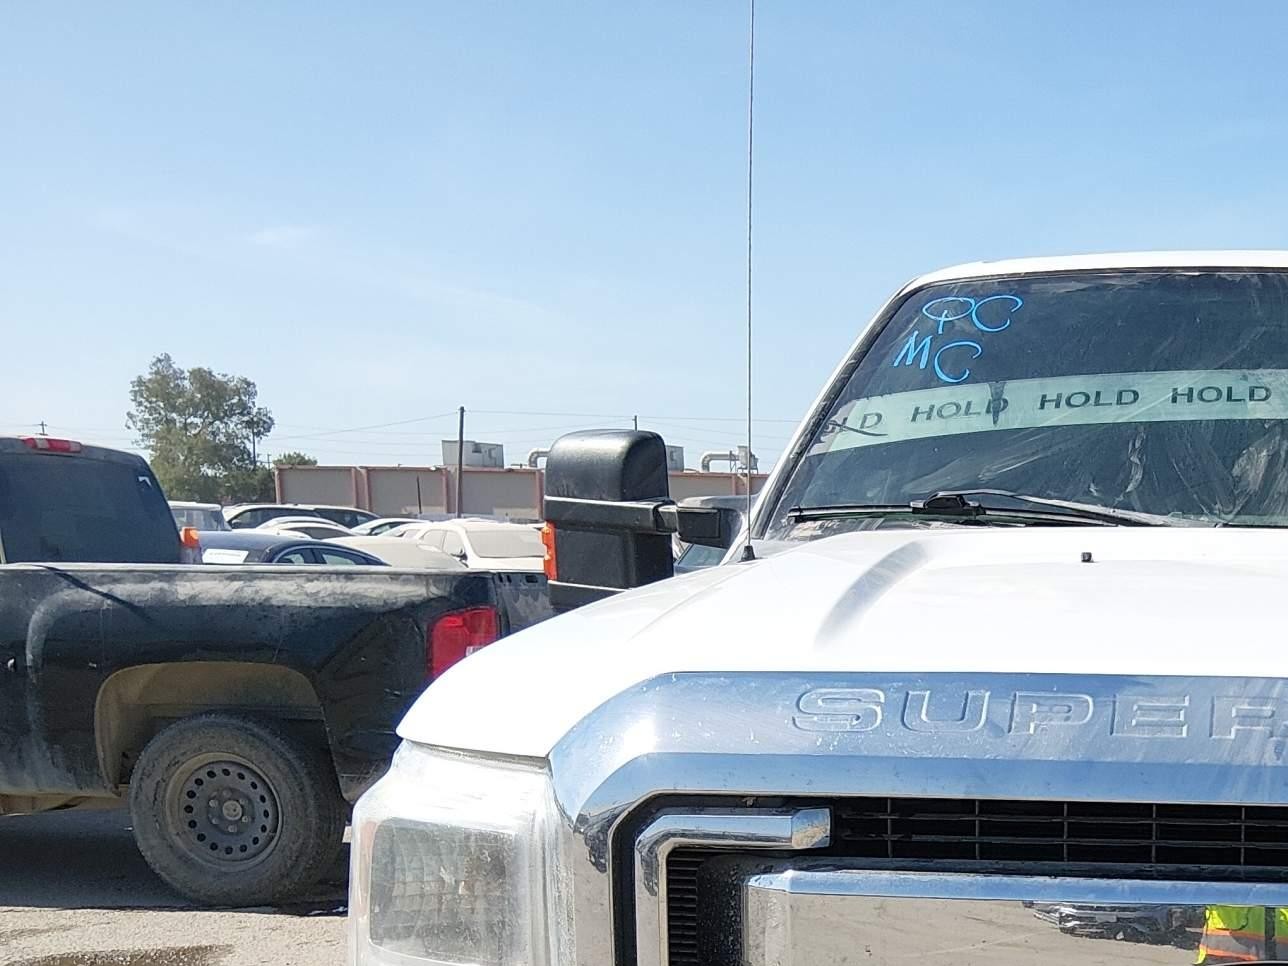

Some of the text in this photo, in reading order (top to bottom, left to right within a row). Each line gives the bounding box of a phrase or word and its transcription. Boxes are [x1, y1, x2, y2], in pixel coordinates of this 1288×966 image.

[892, 330, 982, 383] MC
[822, 412, 883, 433] OLD
[911, 398, 1009, 422] HOLD
[1038, 389, 1140, 409] HOLD
[1170, 386, 1272, 403] HOLD
